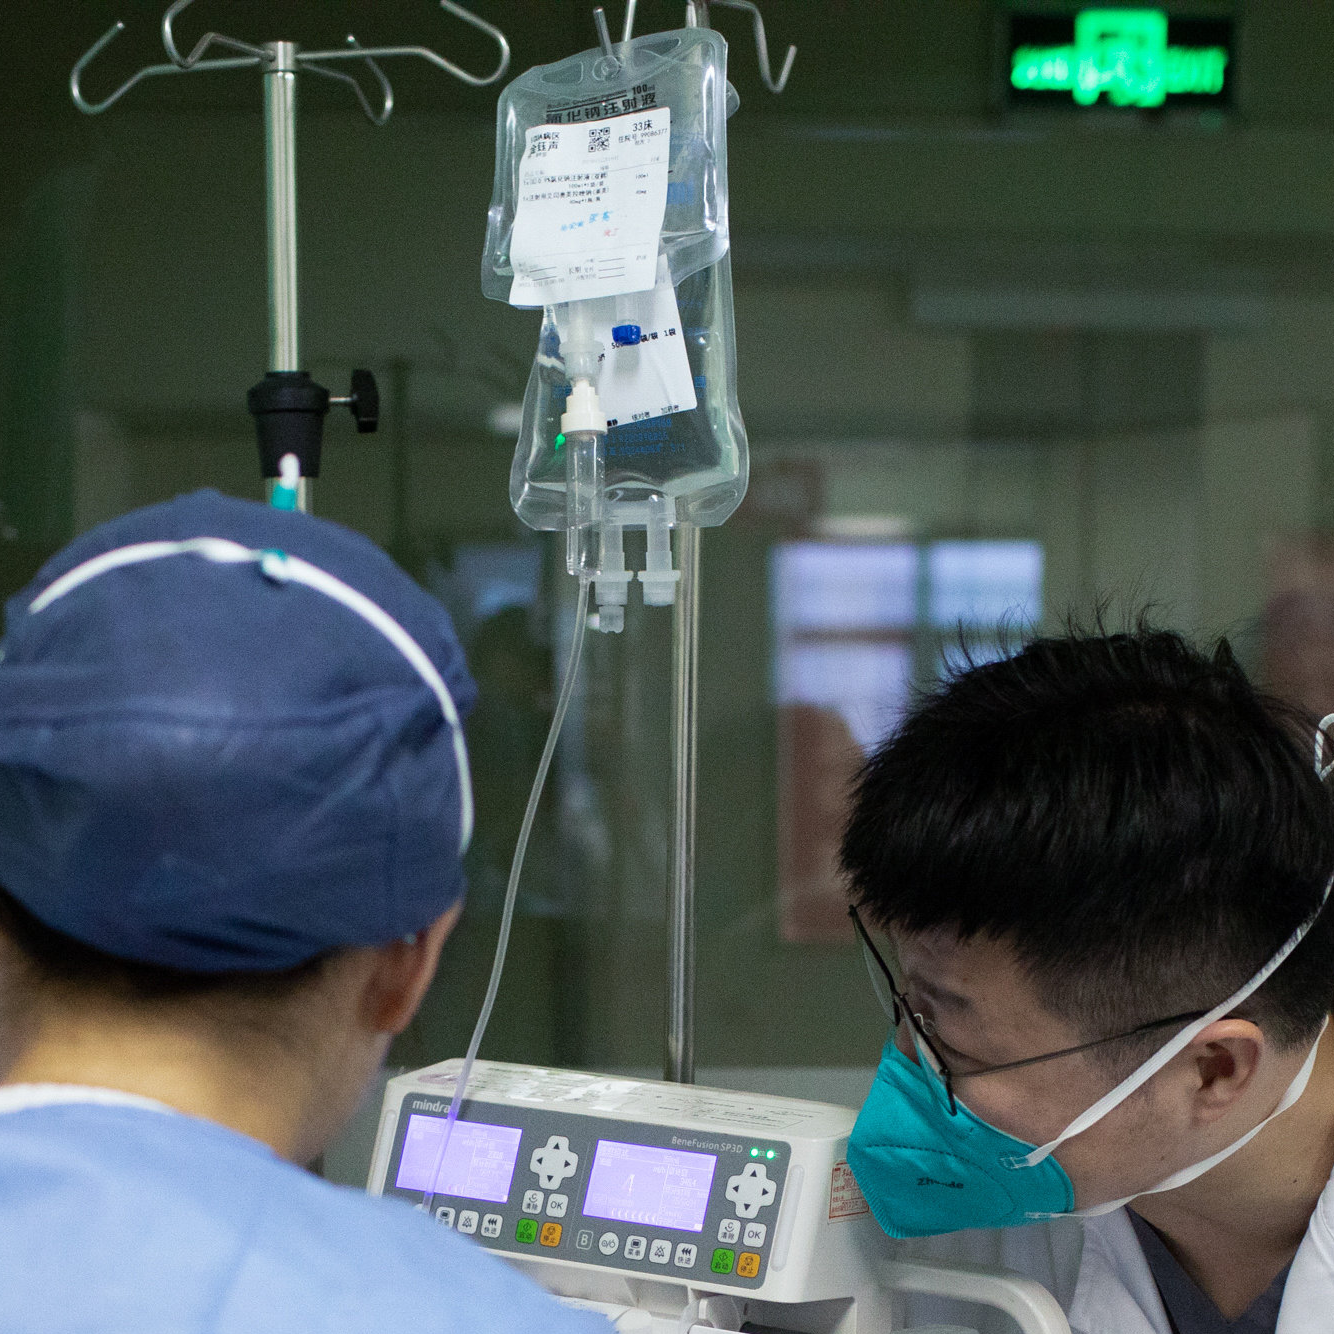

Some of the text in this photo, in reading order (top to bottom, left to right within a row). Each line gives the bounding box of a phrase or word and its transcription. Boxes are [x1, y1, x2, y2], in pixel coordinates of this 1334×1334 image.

[632, 120, 653, 131] 33床
[412, 1099, 451, 1114] mindra
[671, 1136, 743, 1154] BeneFusion SP3D
[550, 1201, 563, 1210] OK
[580, 1234, 589, 1246] B
[747, 1230, 761, 1240] OK
[677, 1255, 692, 1265] 快进
[740, 1265, 754, 1275] 停止
